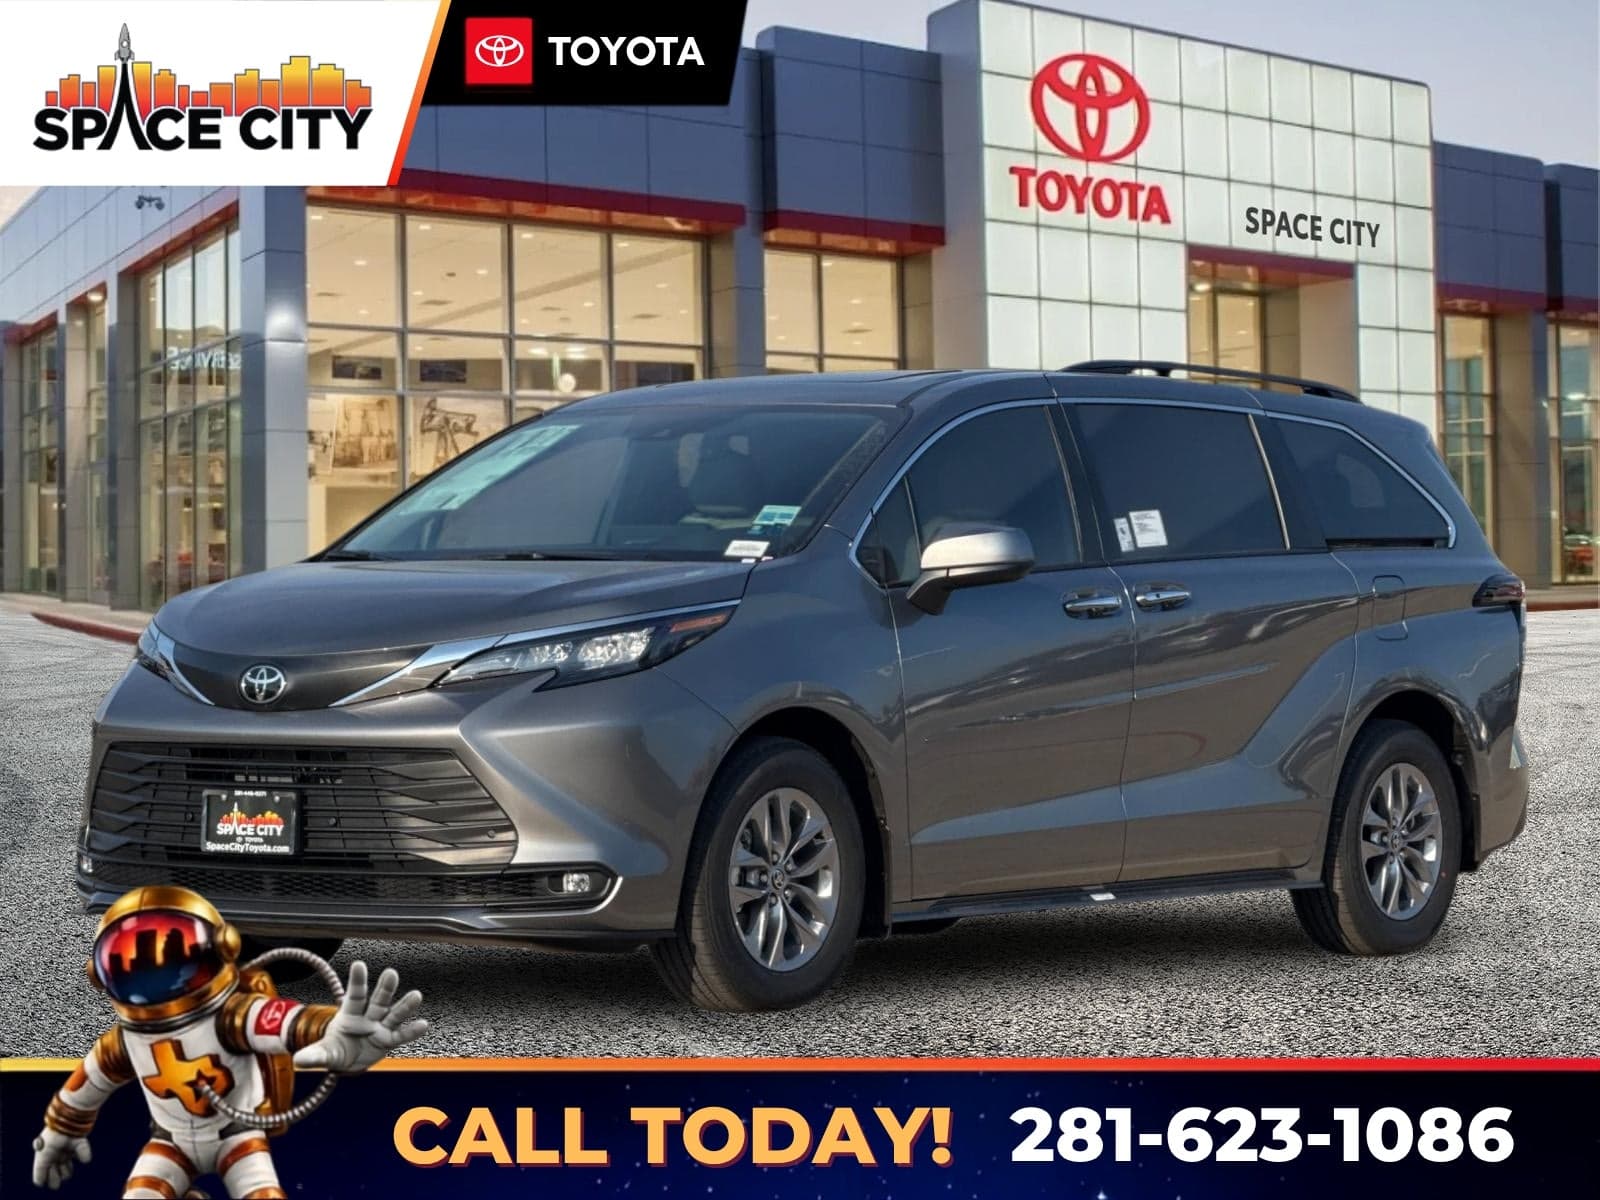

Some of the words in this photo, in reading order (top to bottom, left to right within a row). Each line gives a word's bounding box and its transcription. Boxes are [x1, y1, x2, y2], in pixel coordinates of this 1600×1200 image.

[1009, 165, 1172, 225] TOYOTA
[1245, 206, 1322, 241] SPACE
[1329, 218, 1381, 248] CITY
[216, 822, 255, 836] SPACE
[256, 824, 285, 837] CITY
[206, 841, 290, 854] SpaceCityToyota.com
